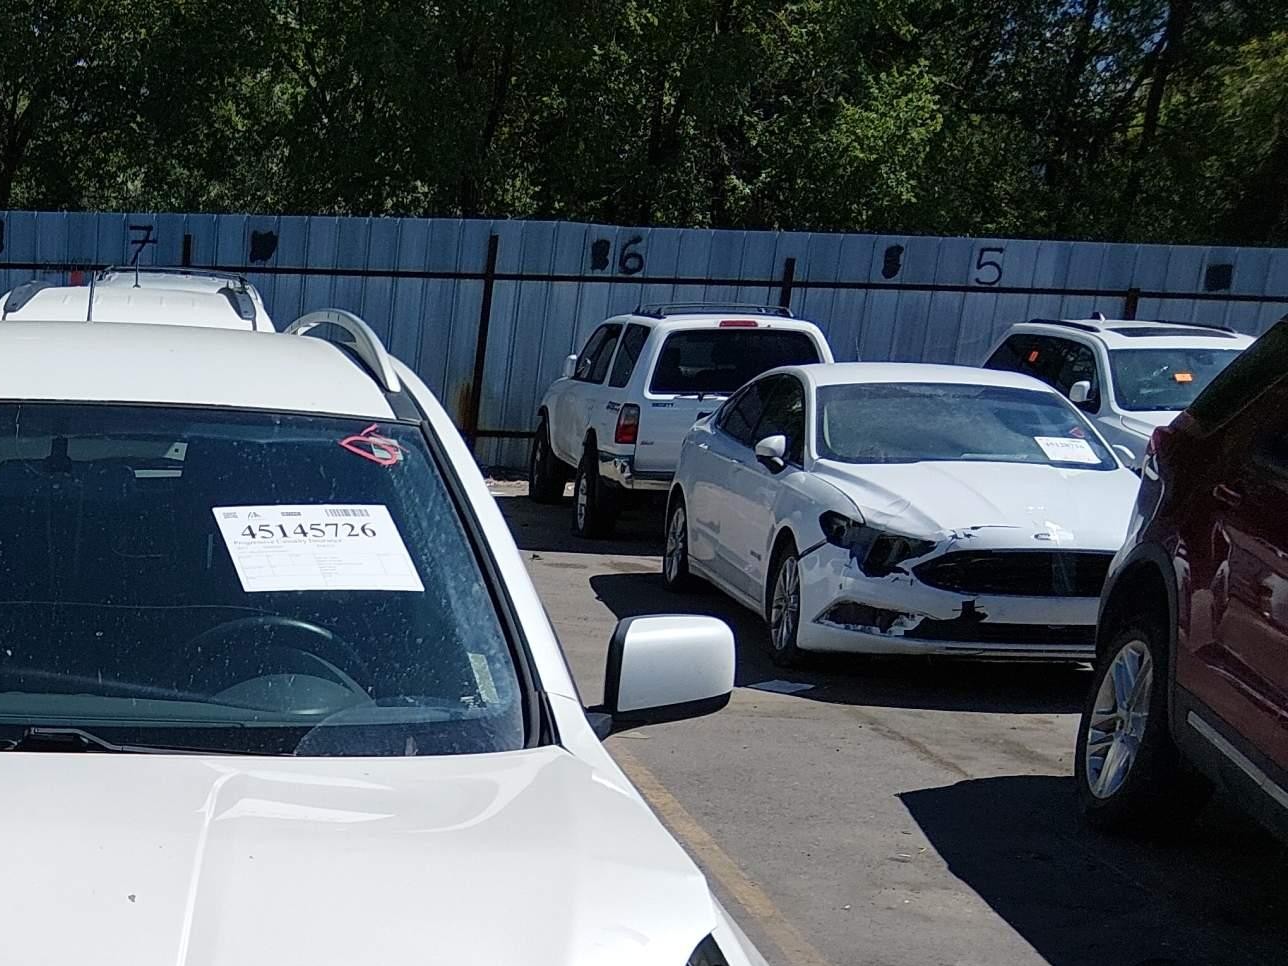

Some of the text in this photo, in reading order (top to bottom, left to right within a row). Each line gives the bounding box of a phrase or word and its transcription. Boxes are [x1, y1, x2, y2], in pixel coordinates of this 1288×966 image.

[129, 225, 158, 265] 7
[618, 235, 644, 274] 6
[975, 247, 1004, 285] 5
[241, 522, 377, 539] 45145726
